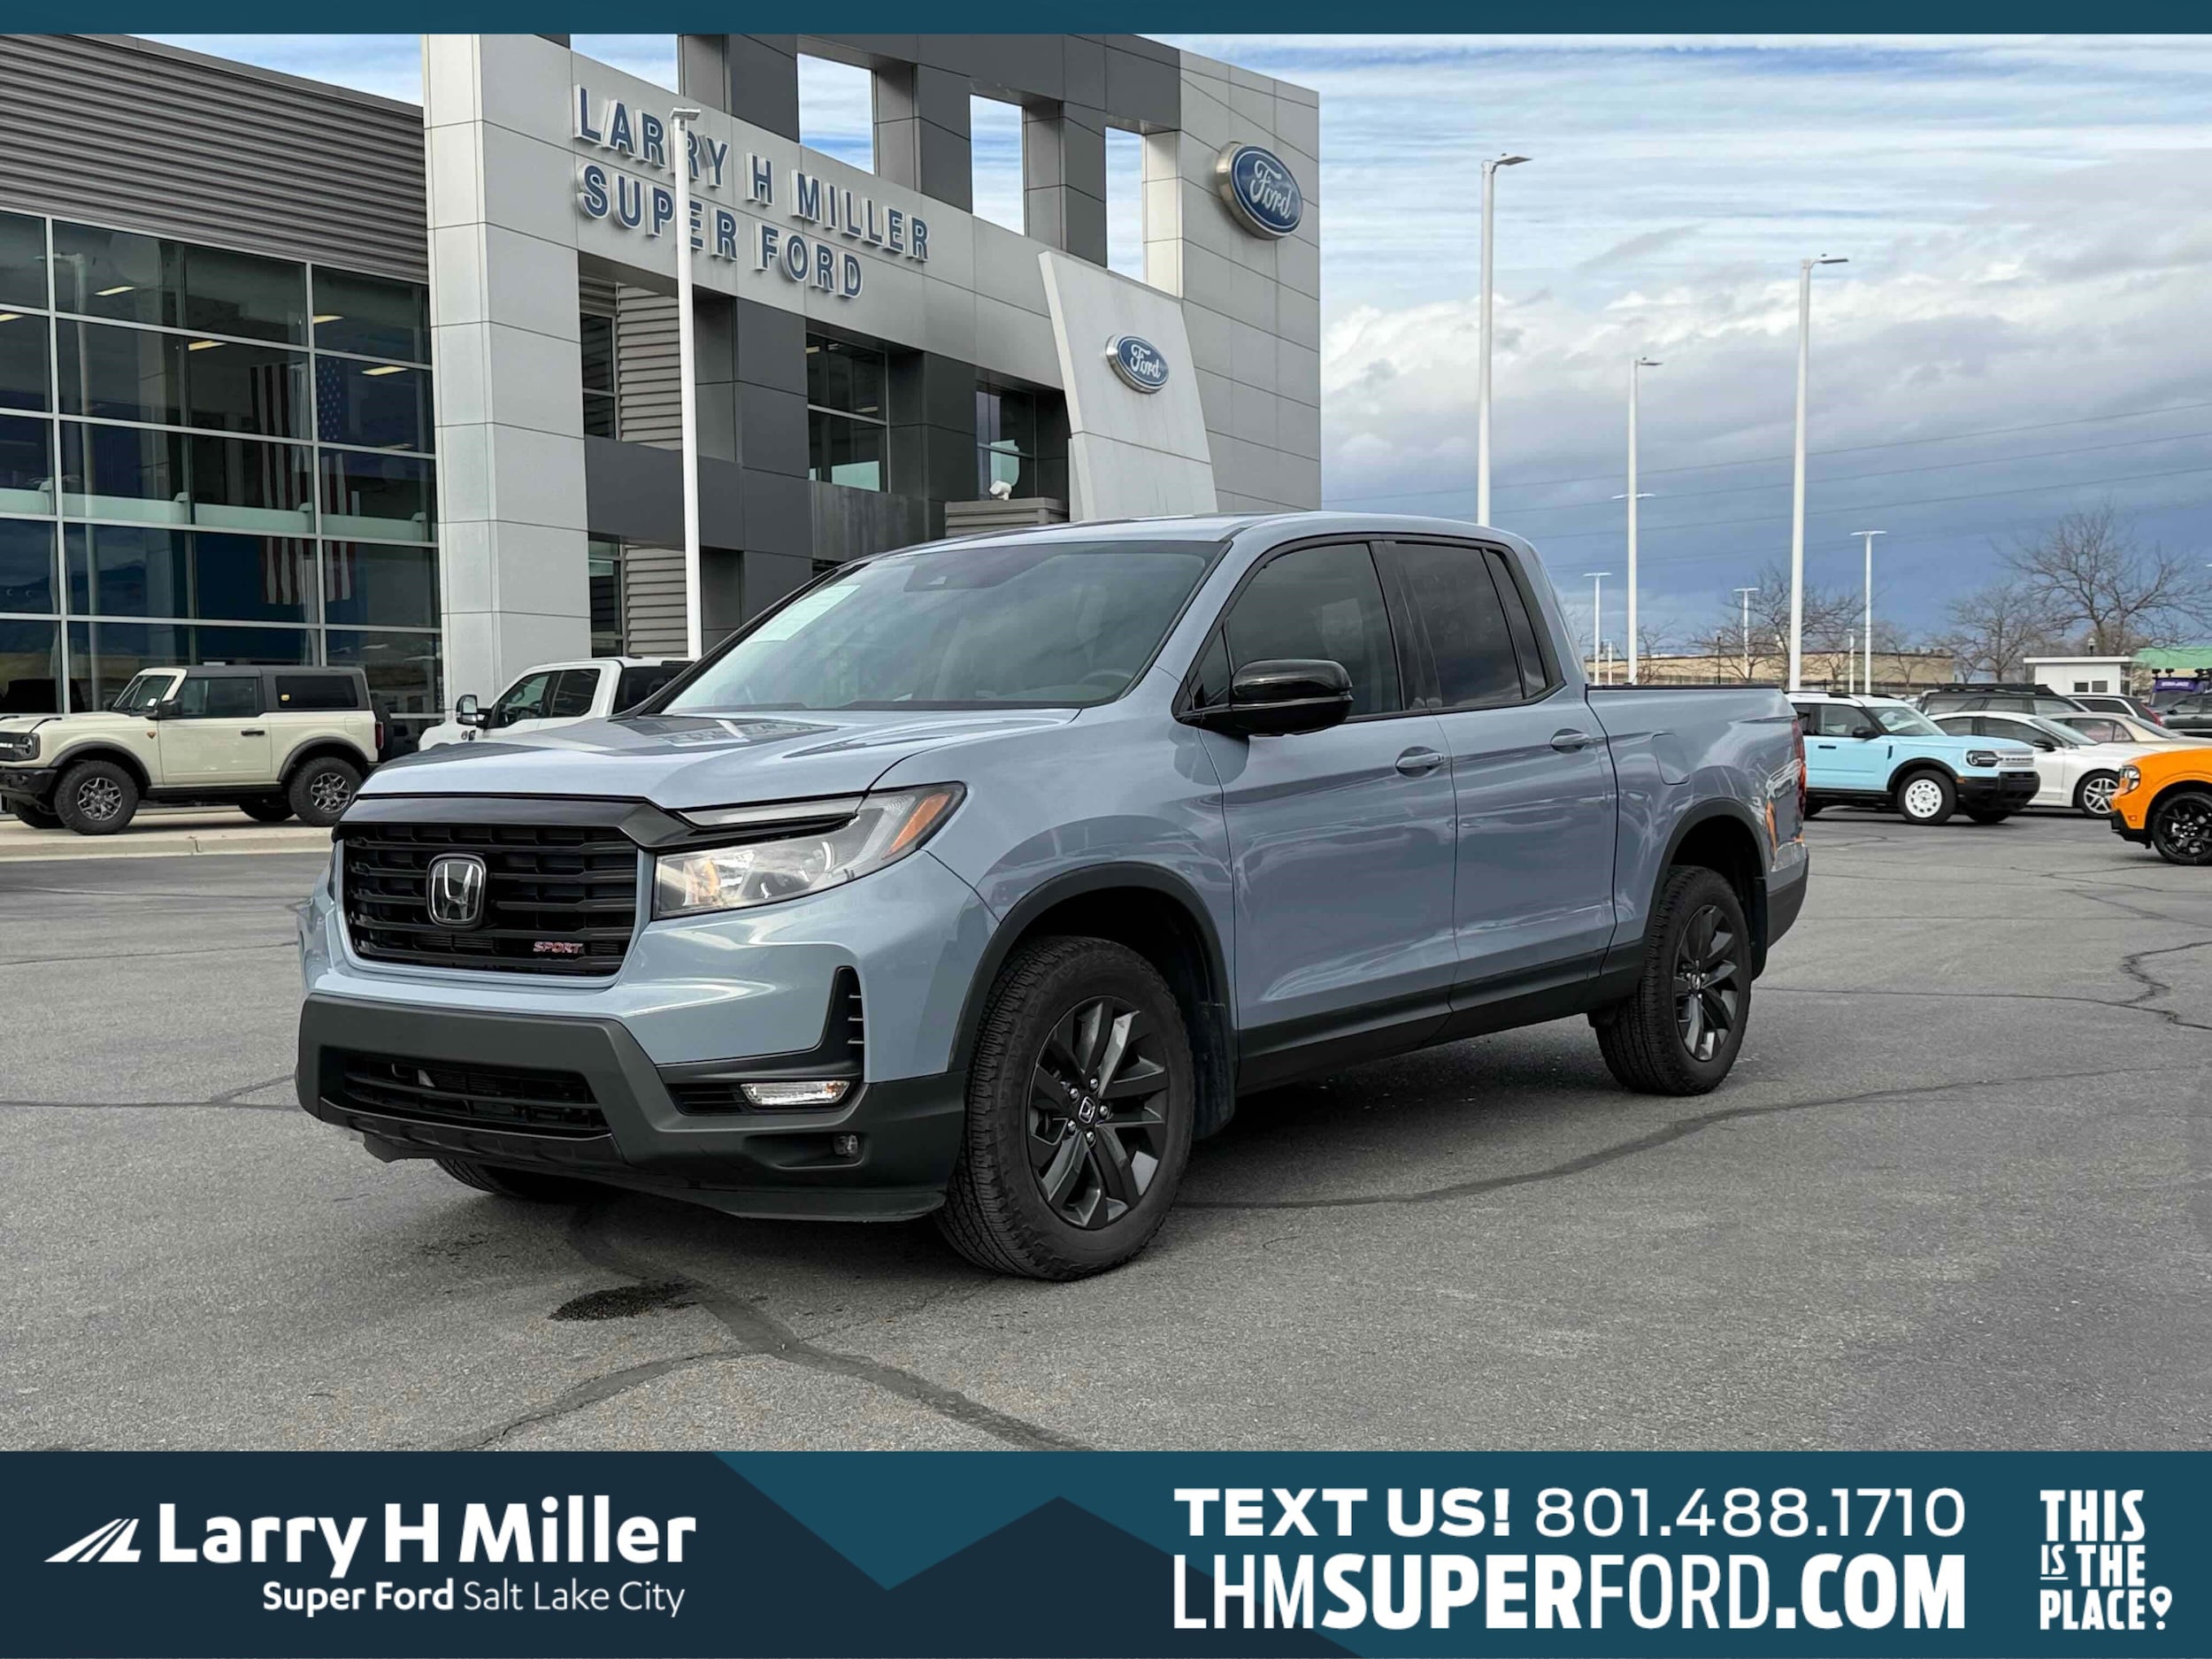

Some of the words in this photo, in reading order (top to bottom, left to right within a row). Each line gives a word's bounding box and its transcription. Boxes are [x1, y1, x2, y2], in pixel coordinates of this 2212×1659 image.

[573, 84, 730, 188] LARRY
[746, 151, 773, 206] H
[791, 169, 930, 262] MILLER
[1249, 159, 1292, 219] Ford
[577, 163, 738, 262] SUPER
[755, 221, 864, 299] FORD
[1130, 343, 1161, 379] Ford
[533, 941, 584, 954] SPORT
